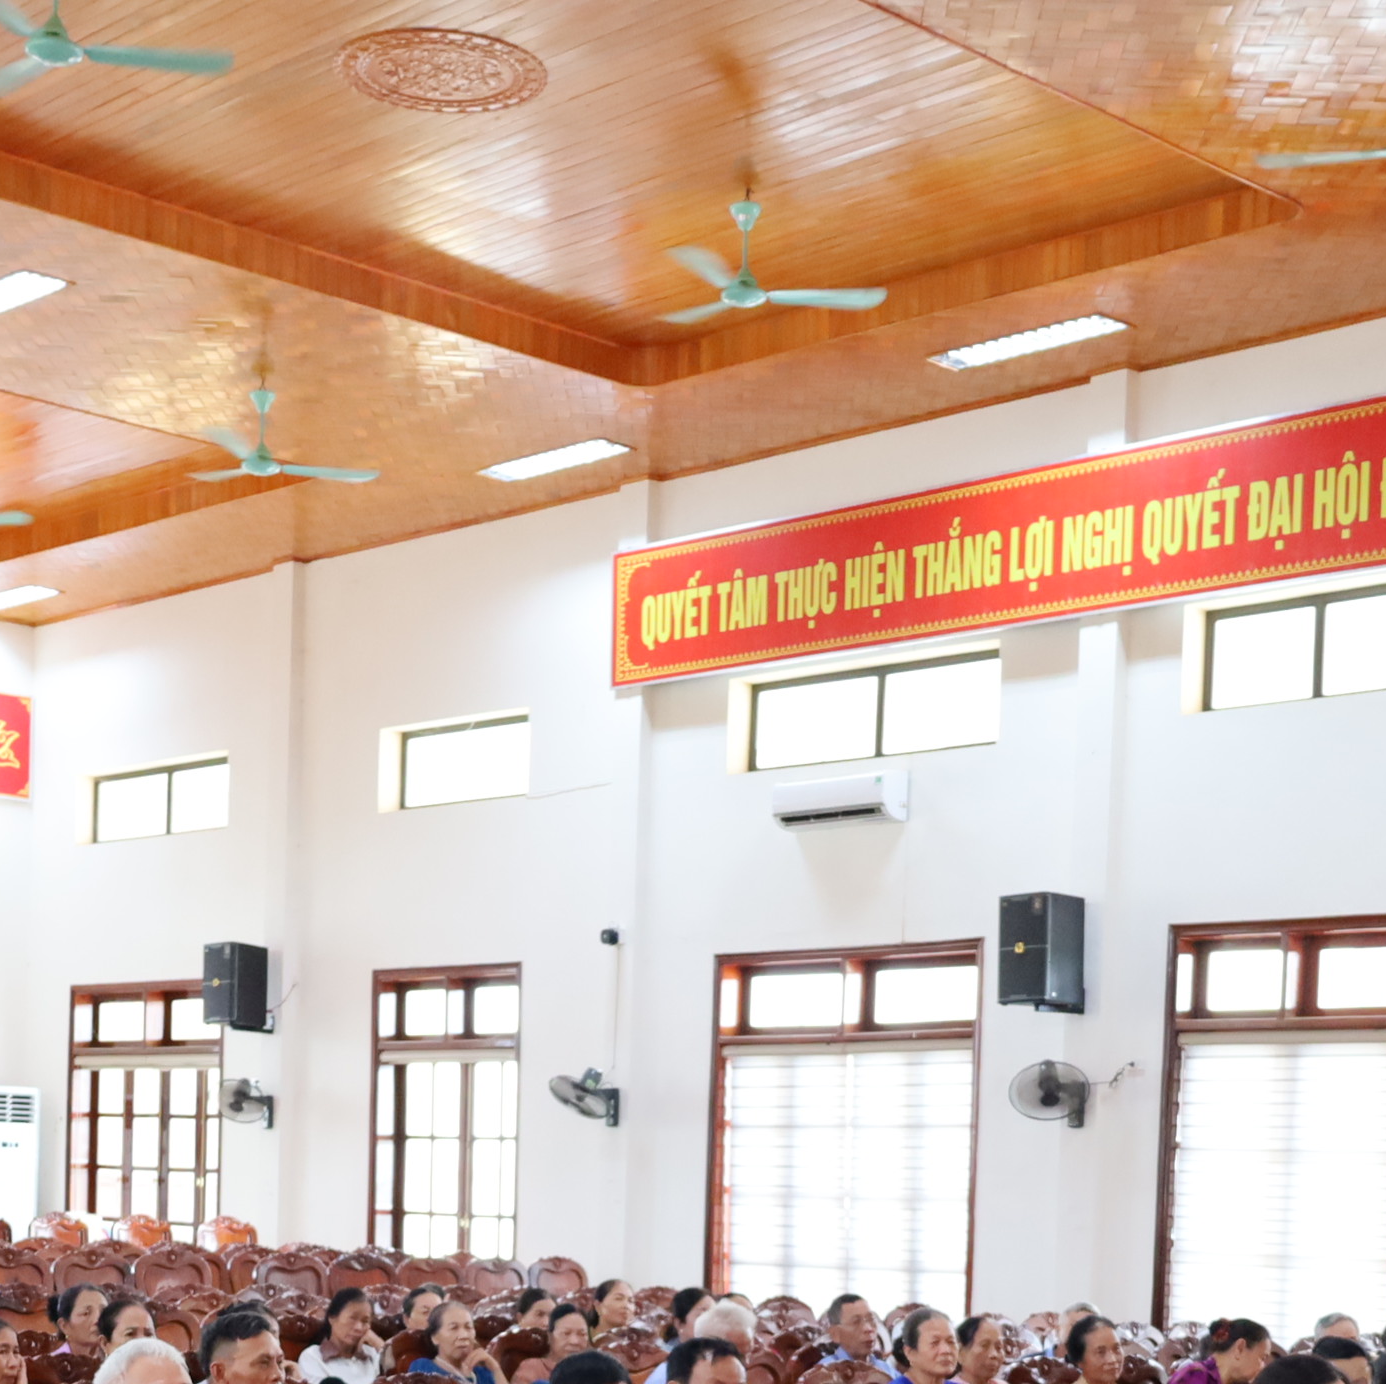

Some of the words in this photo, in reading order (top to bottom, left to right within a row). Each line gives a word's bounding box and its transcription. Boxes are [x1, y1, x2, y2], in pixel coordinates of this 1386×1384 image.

[641, 569, 713, 651] QUYẾT
[717, 569, 768, 633] TÂM
[775, 559, 838, 632] THỰC
[844, 548, 905, 619] HIỆN
[912, 516, 1003, 599] THẮNG
[1009, 515, 1055, 592] LỢI
[1062, 505, 1135, 577] NGHỊ
[1141, 468, 1242, 565] QUYẾT
[1247, 473, 1304, 551] ĐẠI
[1312, 450, 1371, 541] HỘI
